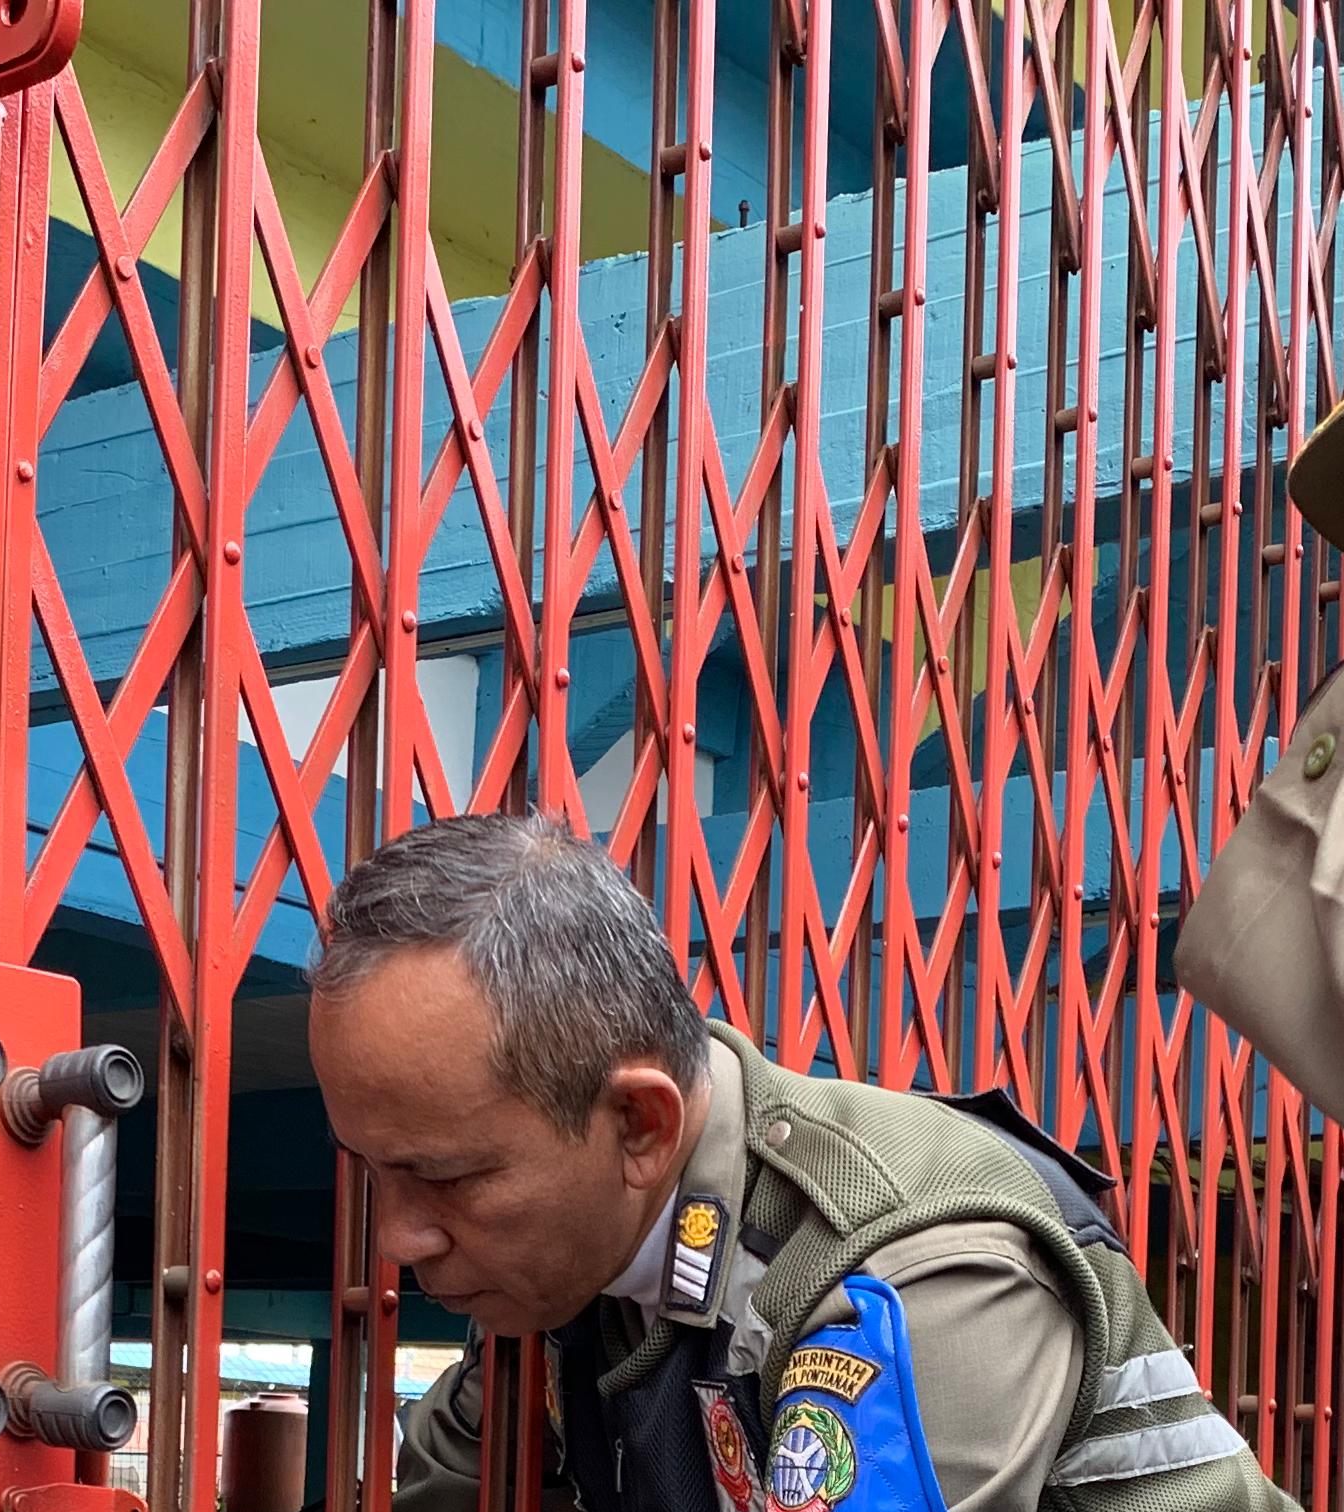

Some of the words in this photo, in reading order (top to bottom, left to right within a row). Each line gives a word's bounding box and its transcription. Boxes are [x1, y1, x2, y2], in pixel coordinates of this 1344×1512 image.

[792, 1350, 868, 1382] MERINTAH
[782, 1370, 798, 1389] OTA
[800, 1369, 859, 1397] PONTIANAK
